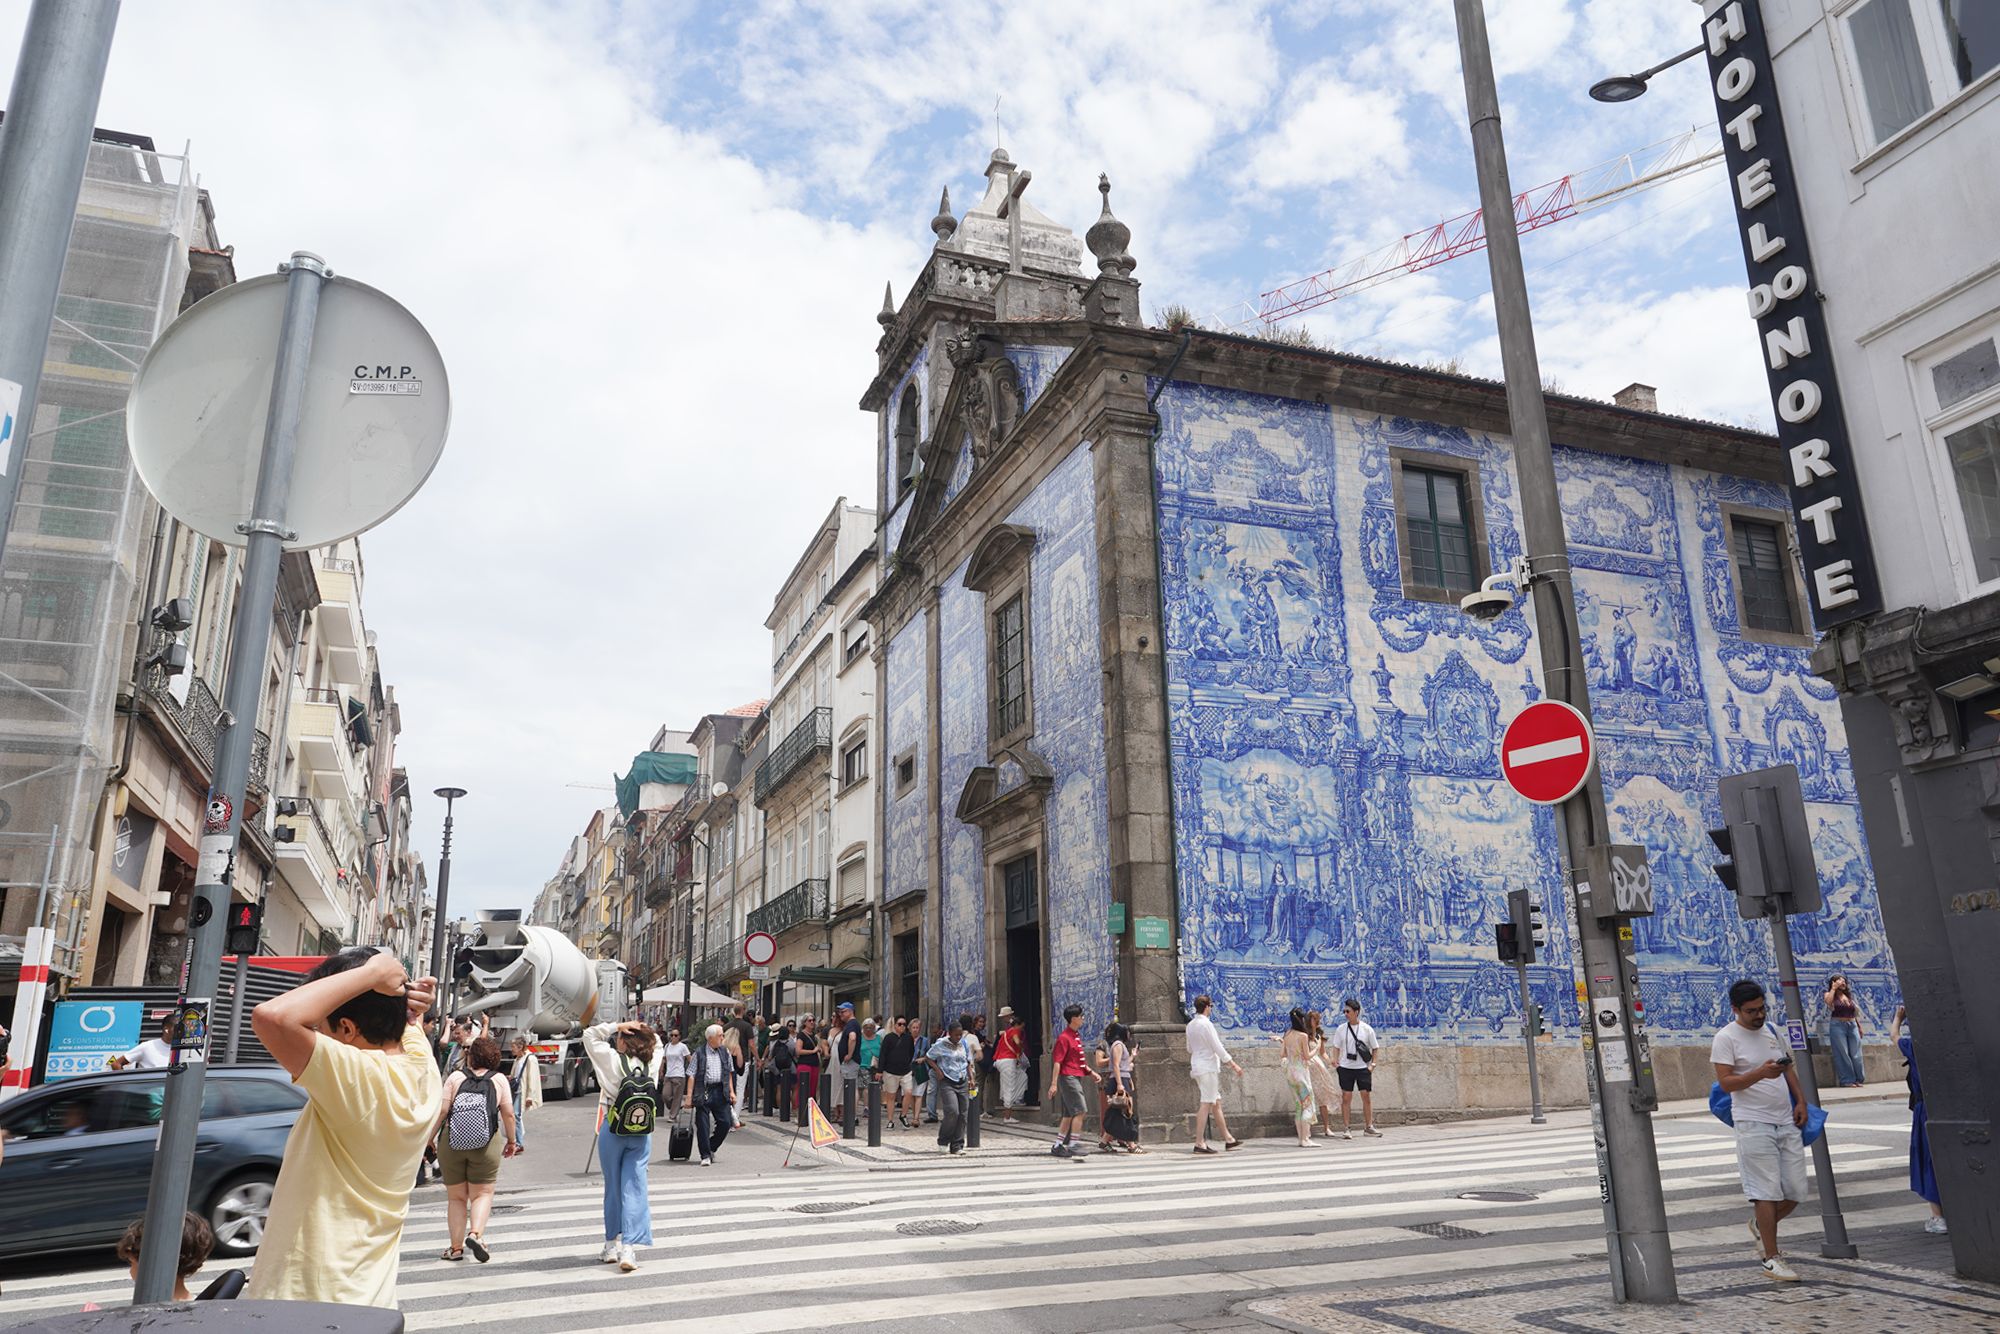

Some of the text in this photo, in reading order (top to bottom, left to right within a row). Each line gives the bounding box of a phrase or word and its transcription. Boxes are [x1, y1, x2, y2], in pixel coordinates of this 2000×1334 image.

[354, 365, 417, 380] C.M.P.
[1706, 1, 1859, 610] HOTEL DO NORTE
